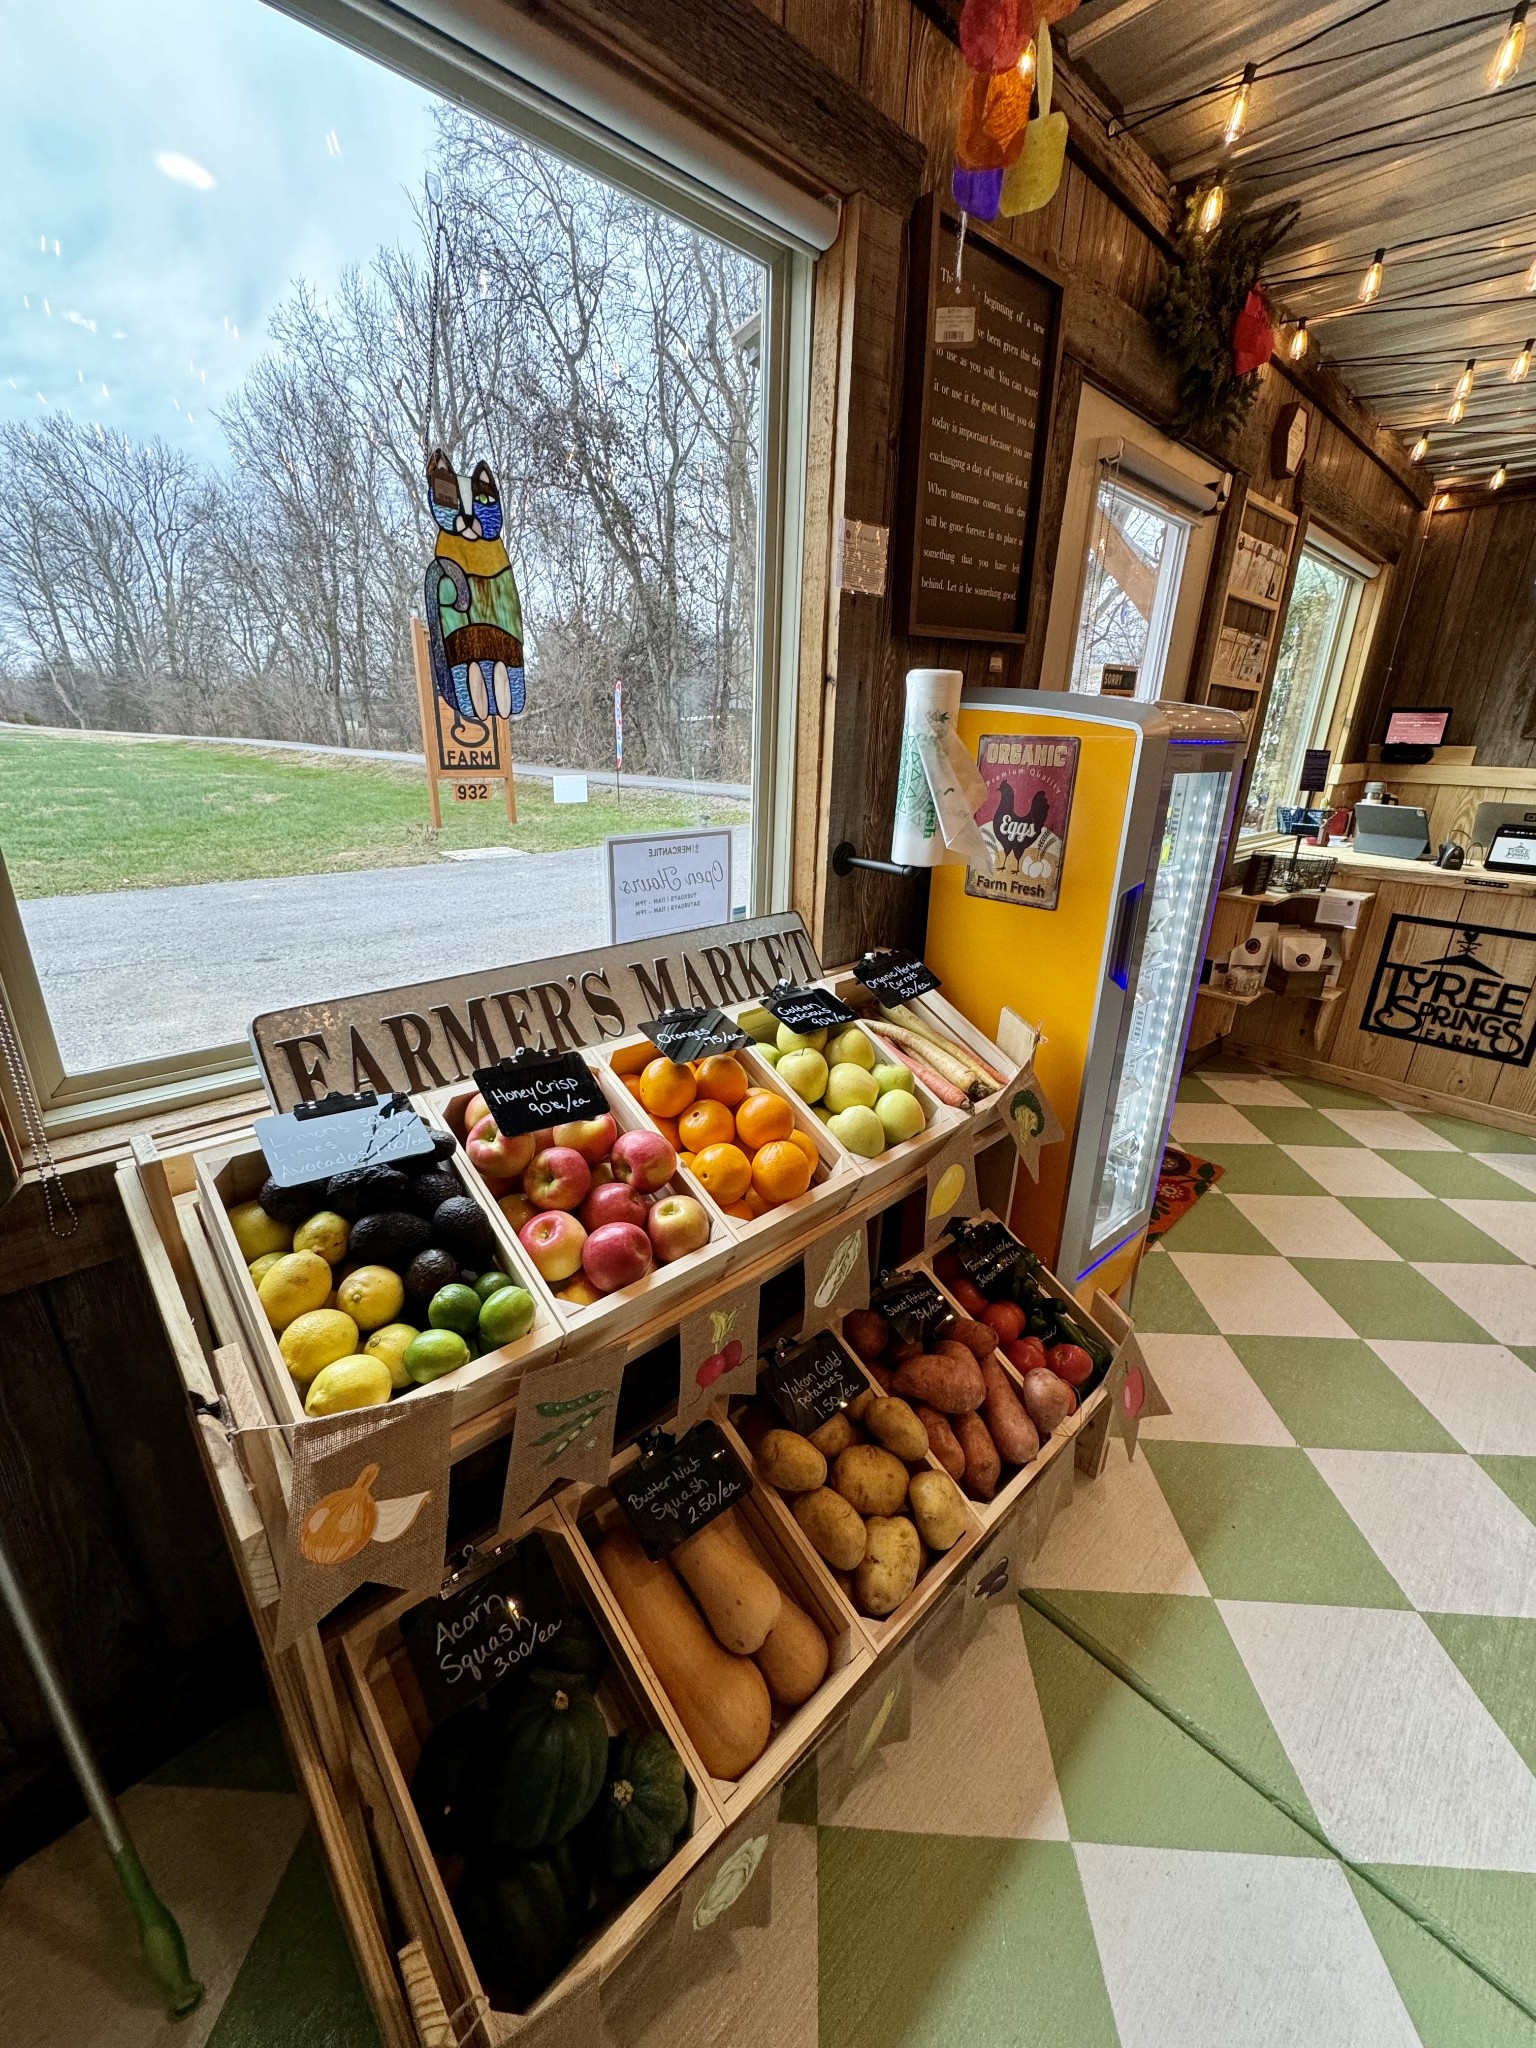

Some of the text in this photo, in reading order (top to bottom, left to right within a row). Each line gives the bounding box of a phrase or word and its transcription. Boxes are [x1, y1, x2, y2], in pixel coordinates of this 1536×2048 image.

[983, 291, 1014, 320] beginning
[1017, 312, 1024, 323] of
[1027, 319, 1031, 327] a
[1034, 322, 1045, 335] new
[986, 329, 1001, 347] been
[1003, 339, 1018, 356] given
[1020, 348, 1031, 362] this
[1032, 353, 1041, 370] day
[946, 350, 958, 363] use
[960, 357, 967, 366] as
[969, 361, 981, 373] you
[984, 365, 996, 380] will.
[999, 370, 1010, 387] You
[1011, 380, 1022, 392] can
[1024, 385, 1039, 399] waste
[933, 378, 1036, 430] it or use it for good. What you do
[931, 416, 1032, 460] today is important because you are
[929, 451, 966, 472] exchanging
[966, 463, 971, 471] a
[972, 462, 983, 478] day
[983, 466, 991, 478] of
[992, 470, 1005, 482] your
[1005, 471, 1014, 485] life
[1014, 476, 1023, 488] for
[927, 480, 947, 497] When
[950, 490, 980, 505] tomorrow
[1004, 502, 1014, 514] this
[1016, 506, 1026, 520] day
[925, 514, 937, 527] will
[939, 516, 947, 529] be
[949, 522, 964, 534] gone
[965, 523, 986, 538] forever.
[988, 528, 994, 539] In
[1003, 533, 1017, 546] place
[1019, 536, 1023, 546] is
[923, 548, 1020, 574] something that you have left
[921, 576, 945, 590] behind.
[947, 580, 957, 592] Let
[959, 582, 963, 593] it
[965, 583, 973, 594] be
[974, 587, 1002, 599] something
[447, 751, 493, 766] FARM
[986, 743, 1067, 767] ORGANIC
[457, 784, 488, 800] 932
[986, 768, 1062, 794] Premium Quality
[1000, 814, 1037, 842] Eggs
[976, 875, 1045, 898] Farm Fresh
[627, 928, 817, 1011] MARKET
[866, 971, 898, 989] Organic
[889, 971, 918, 990] Carrots
[1385, 961, 1532, 1020] TYREE
[777, 1003, 821, 1016] Golden
[782, 1007, 831, 1024] Delicious
[657, 1028, 711, 1044] Oranges
[1373, 995, 1525, 1057] SPRINGS
[1425, 1029, 1480, 1050] FARM
[491, 1078, 579, 1105] Honey Crisp
[269, 1124, 349, 1148] Lemons
[272, 1140, 338, 1163] Limes
[281, 1151, 370, 1180] Avocados
[883, 1289, 937, 1316] Sweet Potatoes
[780, 1350, 842, 1403] Yukon Gold
[797, 1371, 844, 1410] potatoes
[813, 1381, 860, 1419] 1.50/ea
[627, 1457, 701, 1510] Butter Nut
[650, 1477, 709, 1520] Squash
[688, 1479, 741, 1525] 2.50/ea
[436, 1593, 504, 1656] Acorn
[439, 1610, 532, 1684] Squash
